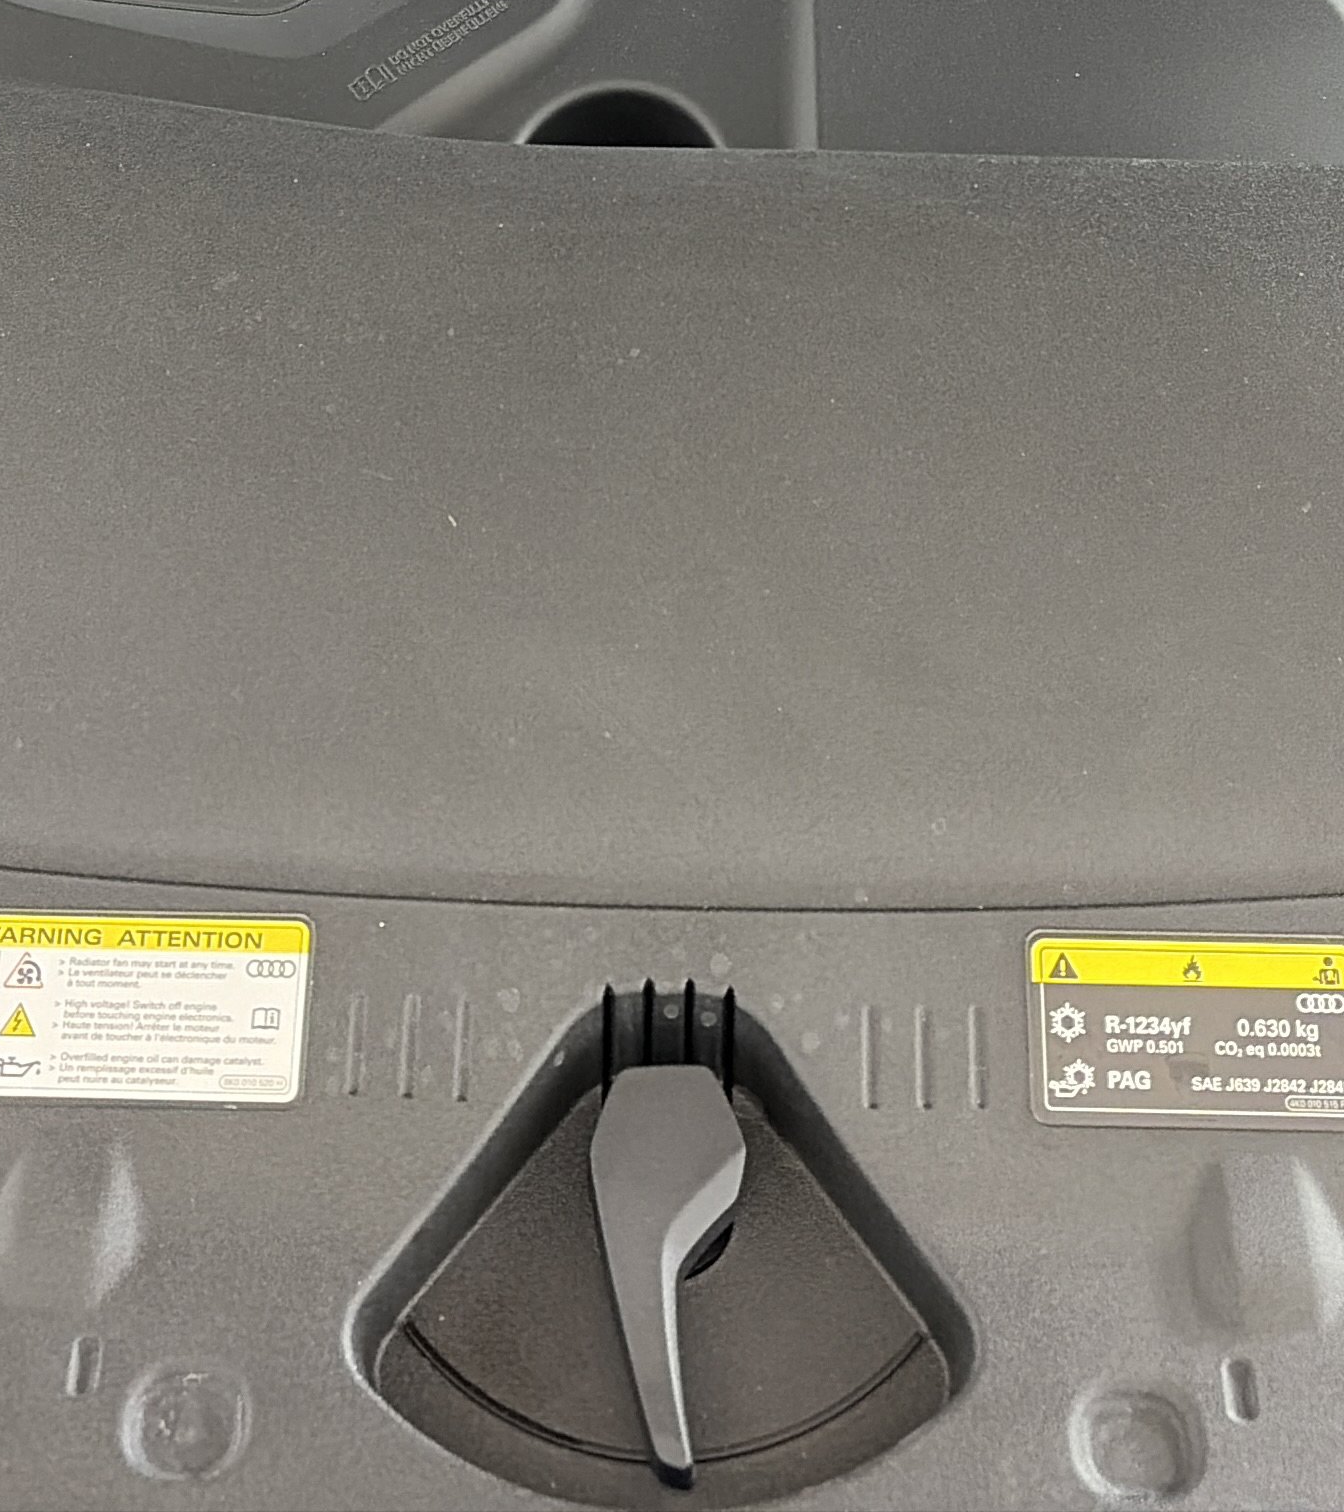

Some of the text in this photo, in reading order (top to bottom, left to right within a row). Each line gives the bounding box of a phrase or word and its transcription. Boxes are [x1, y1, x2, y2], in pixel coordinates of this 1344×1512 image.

[117, 929, 263, 949] ATTENTION
[69, 957, 110, 967] Radiator
[113, 958, 128, 967] fan
[131, 960, 151, 969] may
[155, 960, 176, 968] start
[191, 961, 207, 970] any
[82, 969, 134, 978] ventilateur
[137, 970, 158, 979] peut
[65, 999, 87, 1010] High
[133, 1001, 166, 1010] Switch
[169, 1001, 182, 1010] off
[184, 1003, 218, 1013] engine
[64, 1010, 95, 1019] before
[98, 1011, 140, 1022] touching
[143, 1013, 176, 1023] engine
[63, 1021, 91, 1030] Haute
[173, 1023, 182, 1031] le
[1105, 1015, 1191, 1038] R-1234yf
[1237, 1019, 1319, 1042] 0.630 kg
[61, 1032, 88, 1040] avant
[91, 1032, 103, 1040] de
[106, 1032, 143, 1041] toucher
[223, 1035, 236, 1044] du
[1107, 1039, 1184, 1054] GWP 0.501
[1246, 1044, 1265, 1058] eq
[1268, 1042, 1322, 1058] 0.0003t
[60, 1052, 108, 1063] Overfilled
[110, 1054, 144, 1064] engine
[147, 1054, 159, 1064] oil
[161, 1056, 179, 1064] can
[181, 1056, 221, 1065] damage
[59, 1063, 74, 1072] Un
[77, 1064, 136, 1075] remplissage
[139, 1065, 178, 1074] excessif
[57, 1075, 80, 1085] peut
[83, 1075, 108, 1084] nuire
[1107, 1070, 1151, 1090] PAG
[1191, 1077, 1222, 1091] SAE
[1226, 1077, 1261, 1092] J639
[1264, 1078, 1307, 1094] J2842
